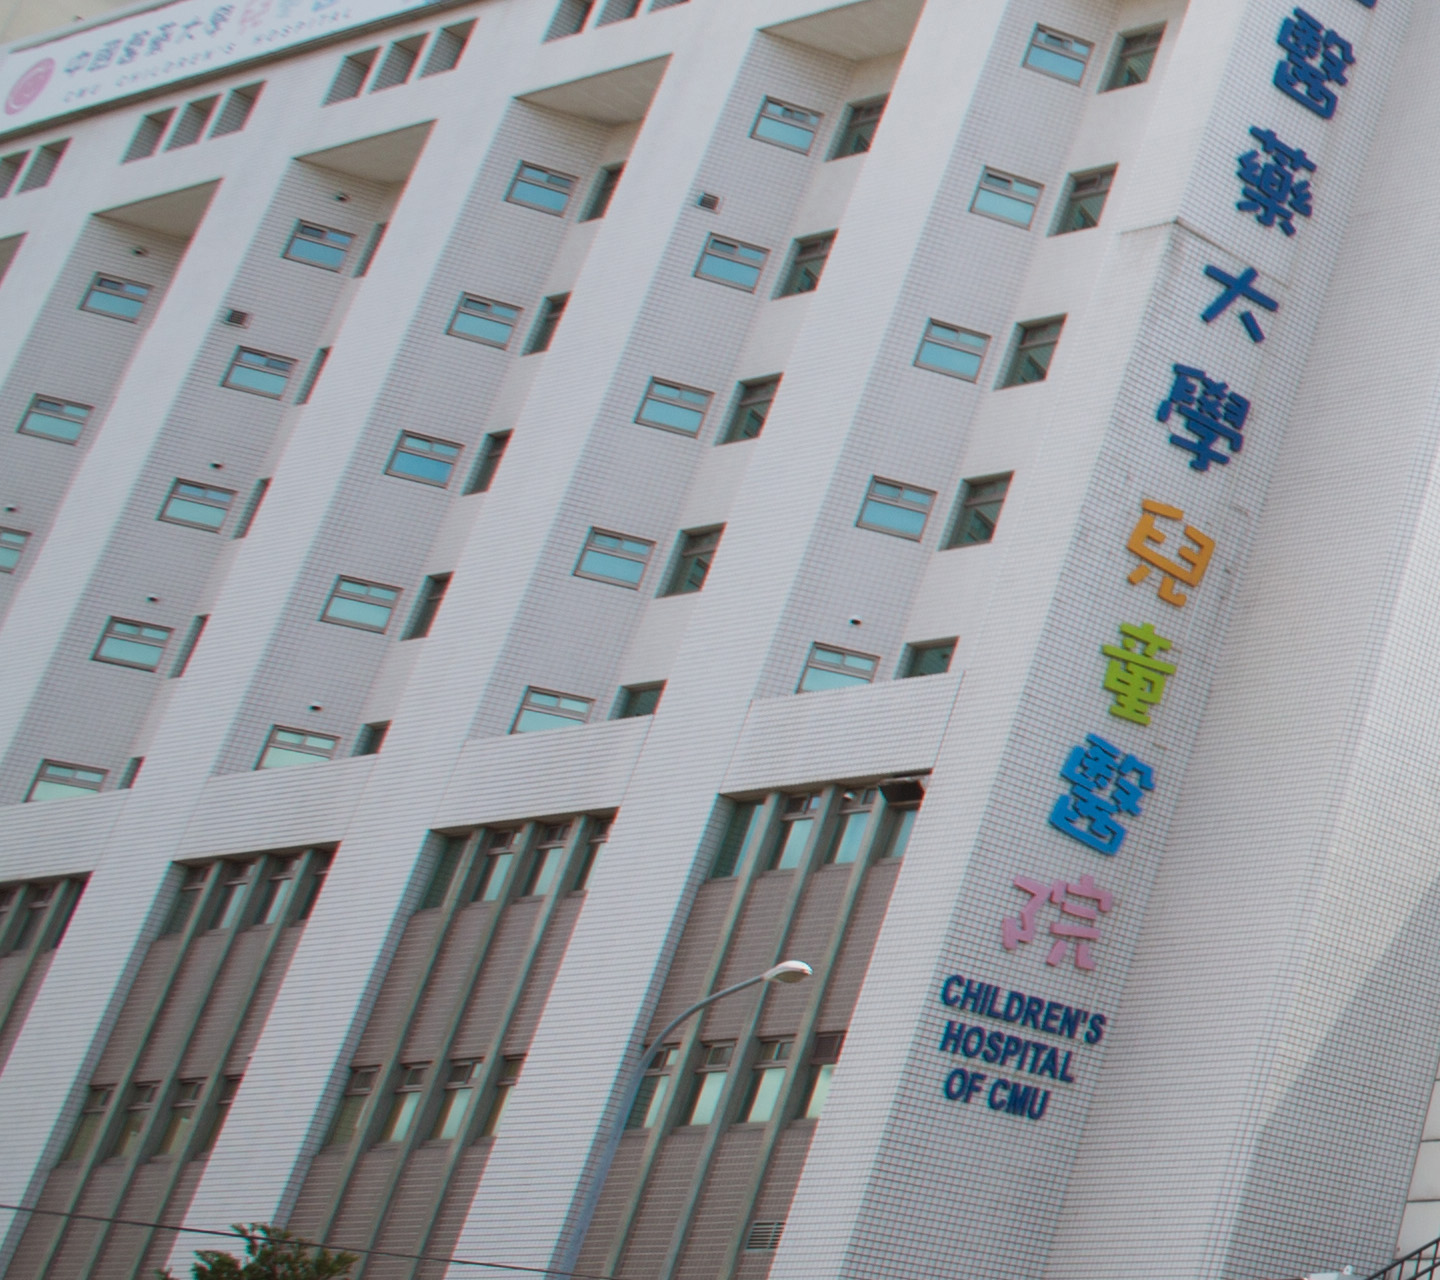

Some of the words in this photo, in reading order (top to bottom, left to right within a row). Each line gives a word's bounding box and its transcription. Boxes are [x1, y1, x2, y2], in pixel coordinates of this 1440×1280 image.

[940, 974, 1107, 1046] CHILDREN'S
[939, 1019, 1076, 1083] HOSPITAL
[943, 1068, 983, 1103] OF
[987, 1076, 1051, 1121] CMU
